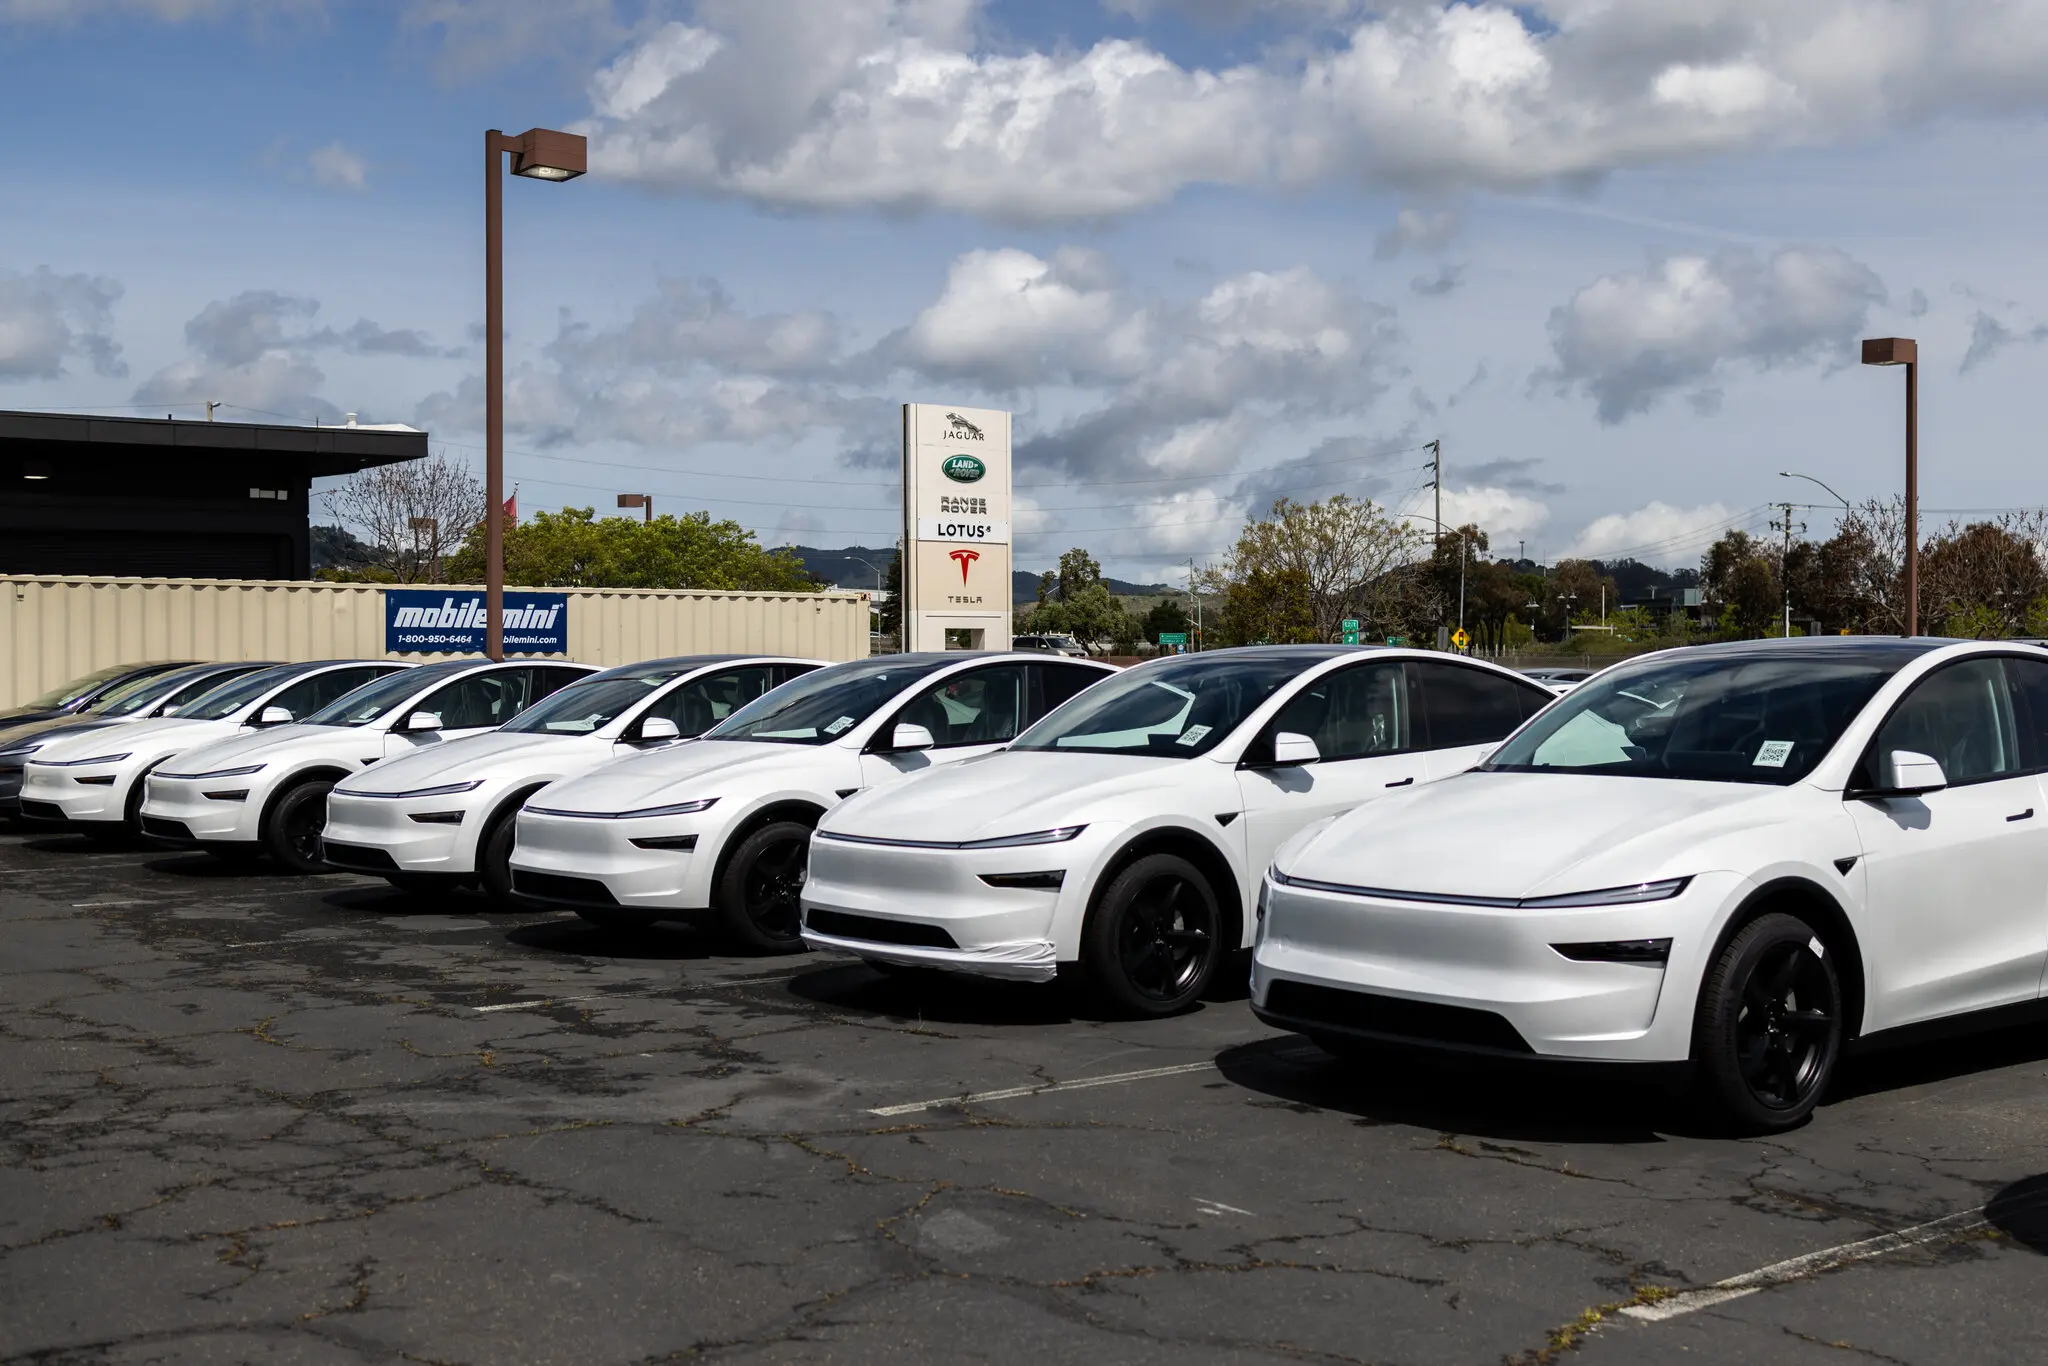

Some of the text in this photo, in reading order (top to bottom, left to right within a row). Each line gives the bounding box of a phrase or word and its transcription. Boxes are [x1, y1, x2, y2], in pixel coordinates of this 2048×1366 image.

[943, 430, 985, 440] JAGUAR
[952, 459, 974, 468] LAND
[953, 468, 980, 478] ROVER
[941, 496, 986, 506] RANGE
[941, 504, 987, 515] ROVER
[938, 523, 985, 537] LOTUS
[948, 595, 983, 604] TESLA
[393, 598, 487, 628] mobile
[398, 635, 558, 644] 1-800-950-6464 bilemini.com
